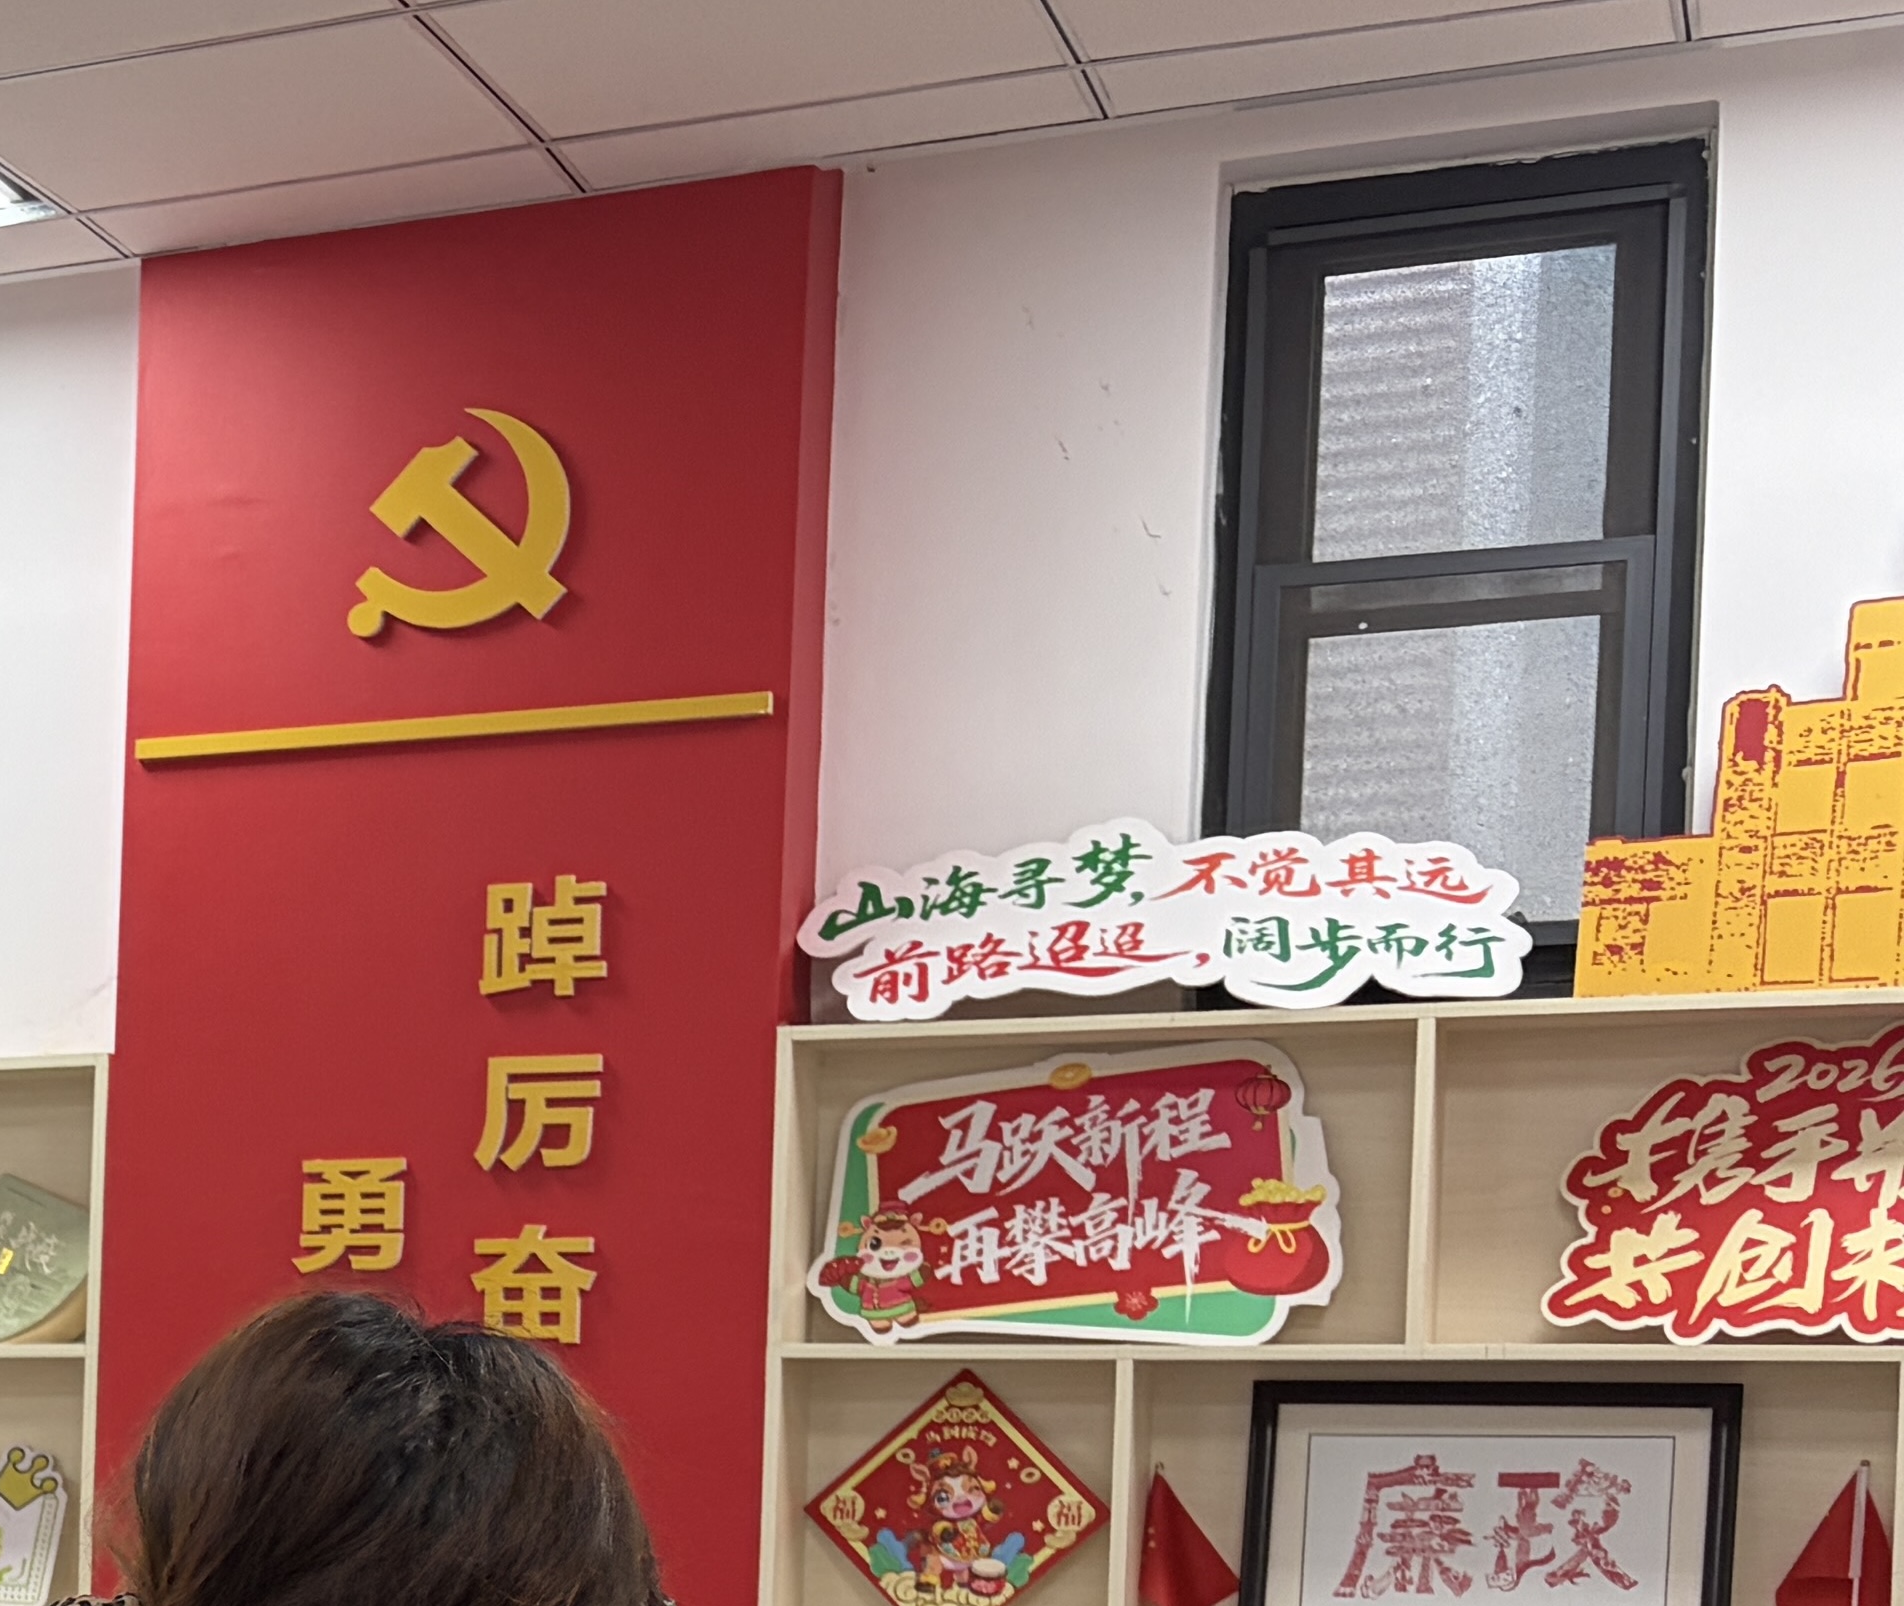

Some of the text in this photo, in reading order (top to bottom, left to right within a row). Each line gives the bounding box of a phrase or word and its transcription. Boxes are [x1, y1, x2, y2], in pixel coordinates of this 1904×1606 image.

[473, 874, 608, 1345] 踔厉奋
[898, 1087, 1233, 1210] 马跃新程
[292, 1156, 408, 1274] 勇
[935, 1170, 1266, 1322] 再攀高峰
[1332, 1453, 1639, 1600] 廉政
